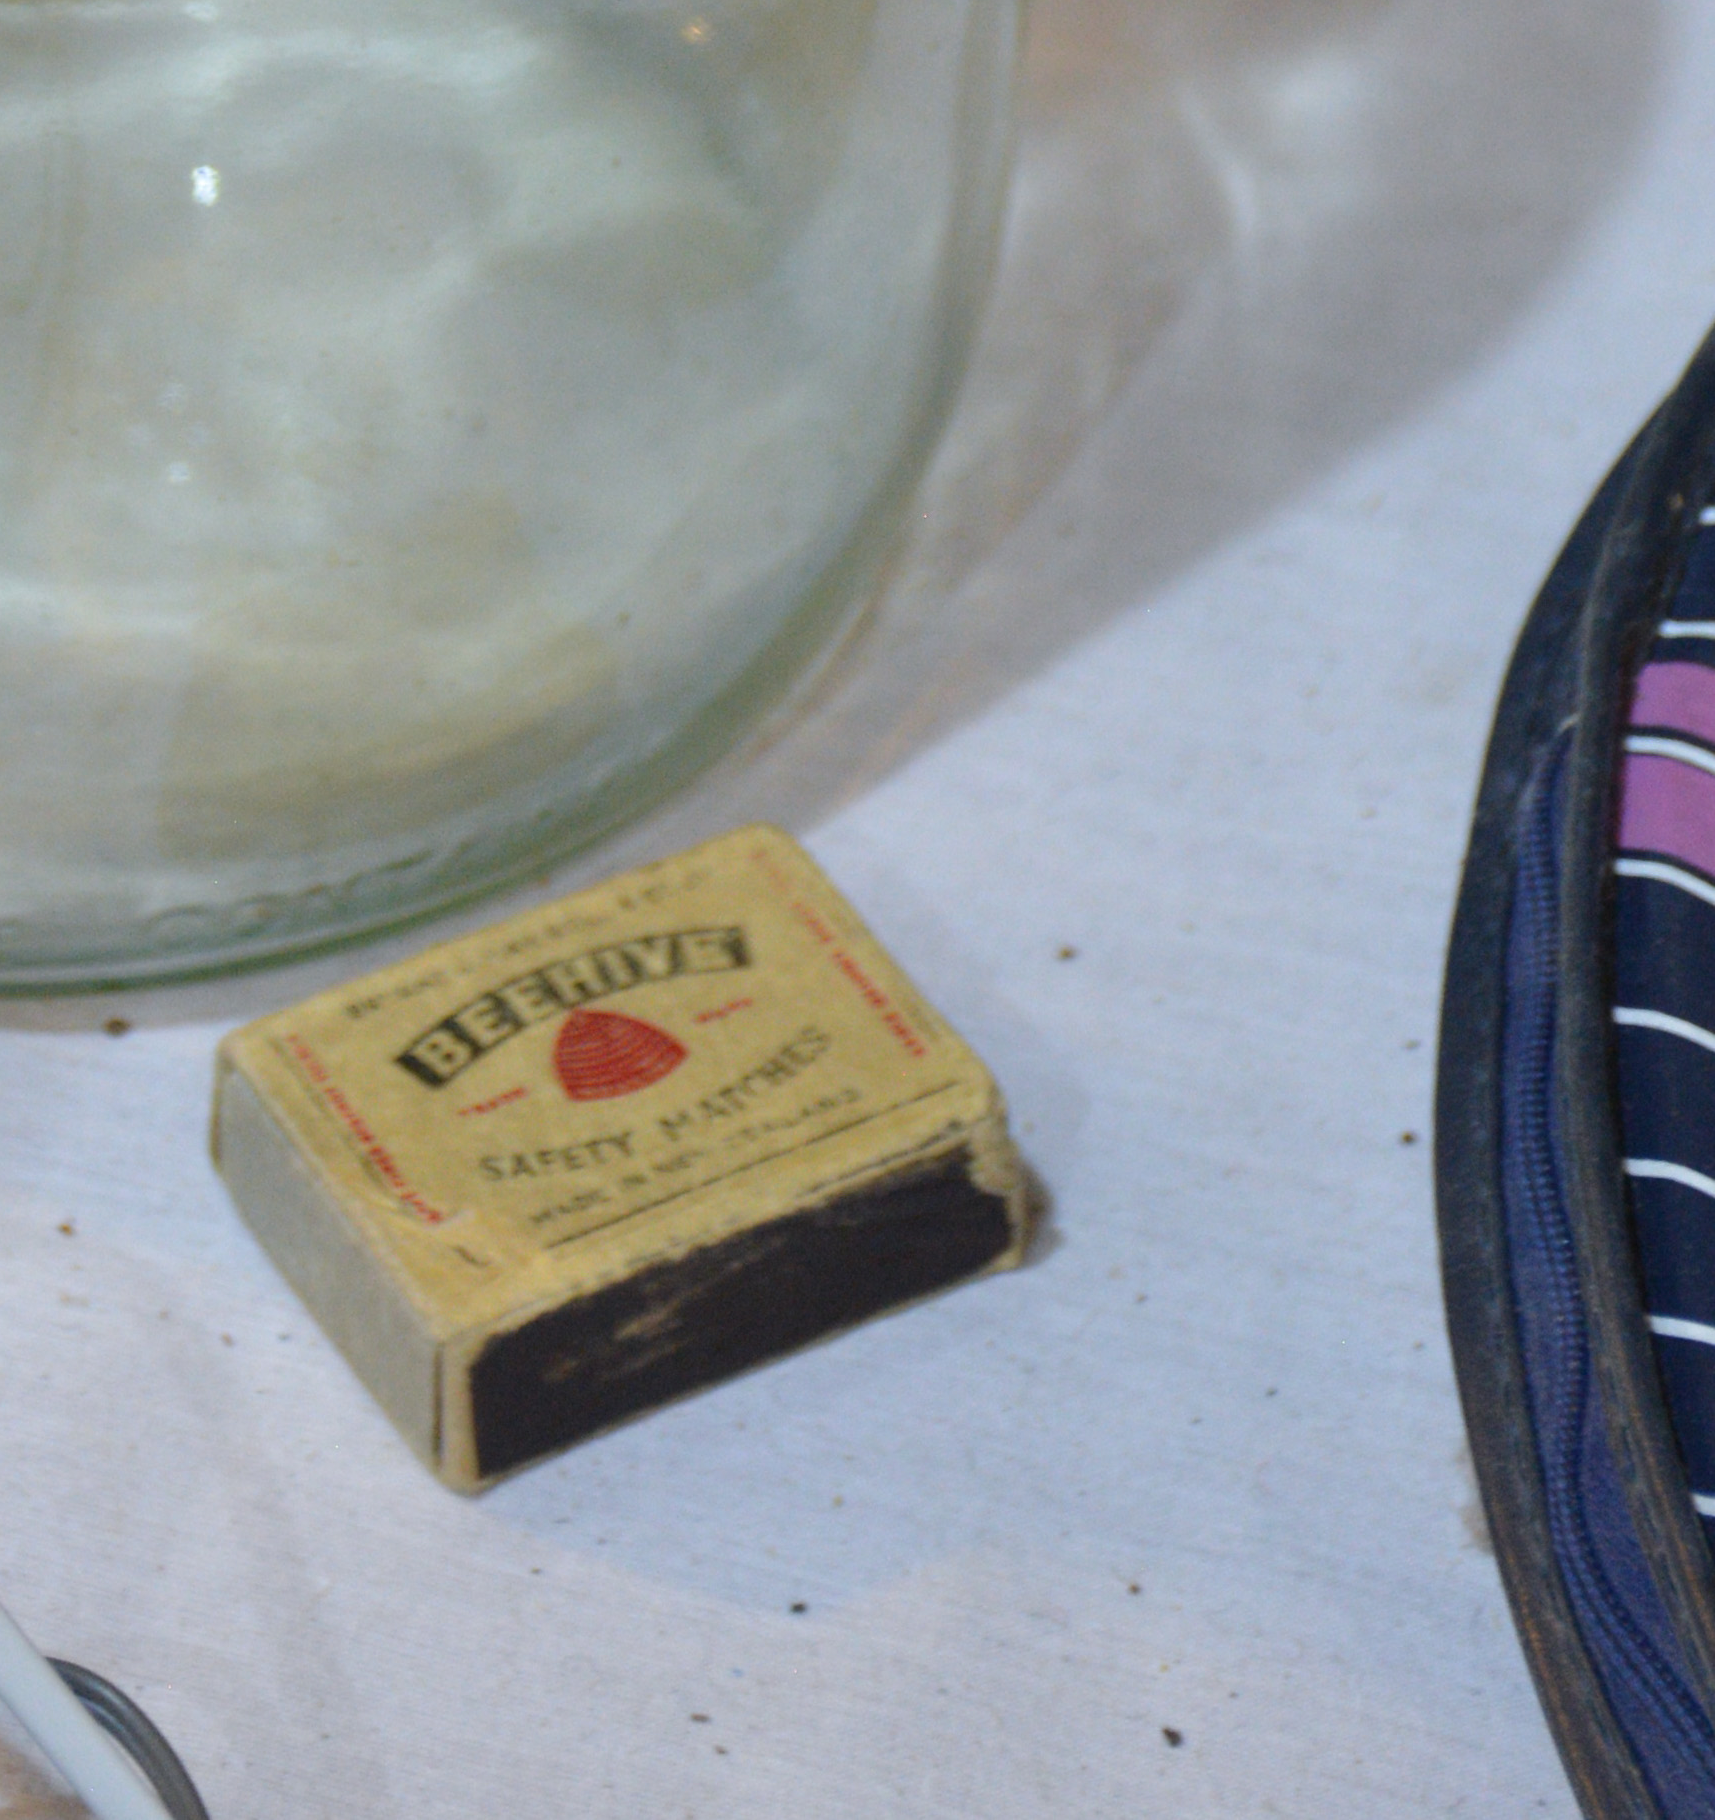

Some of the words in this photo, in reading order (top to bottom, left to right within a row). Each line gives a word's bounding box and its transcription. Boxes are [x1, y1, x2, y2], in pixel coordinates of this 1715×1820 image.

[399, 926, 747, 1085] BEEHIVE
[479, 1130, 635, 1183] SAFETY
[657, 1025, 833, 1143] MATCHES
